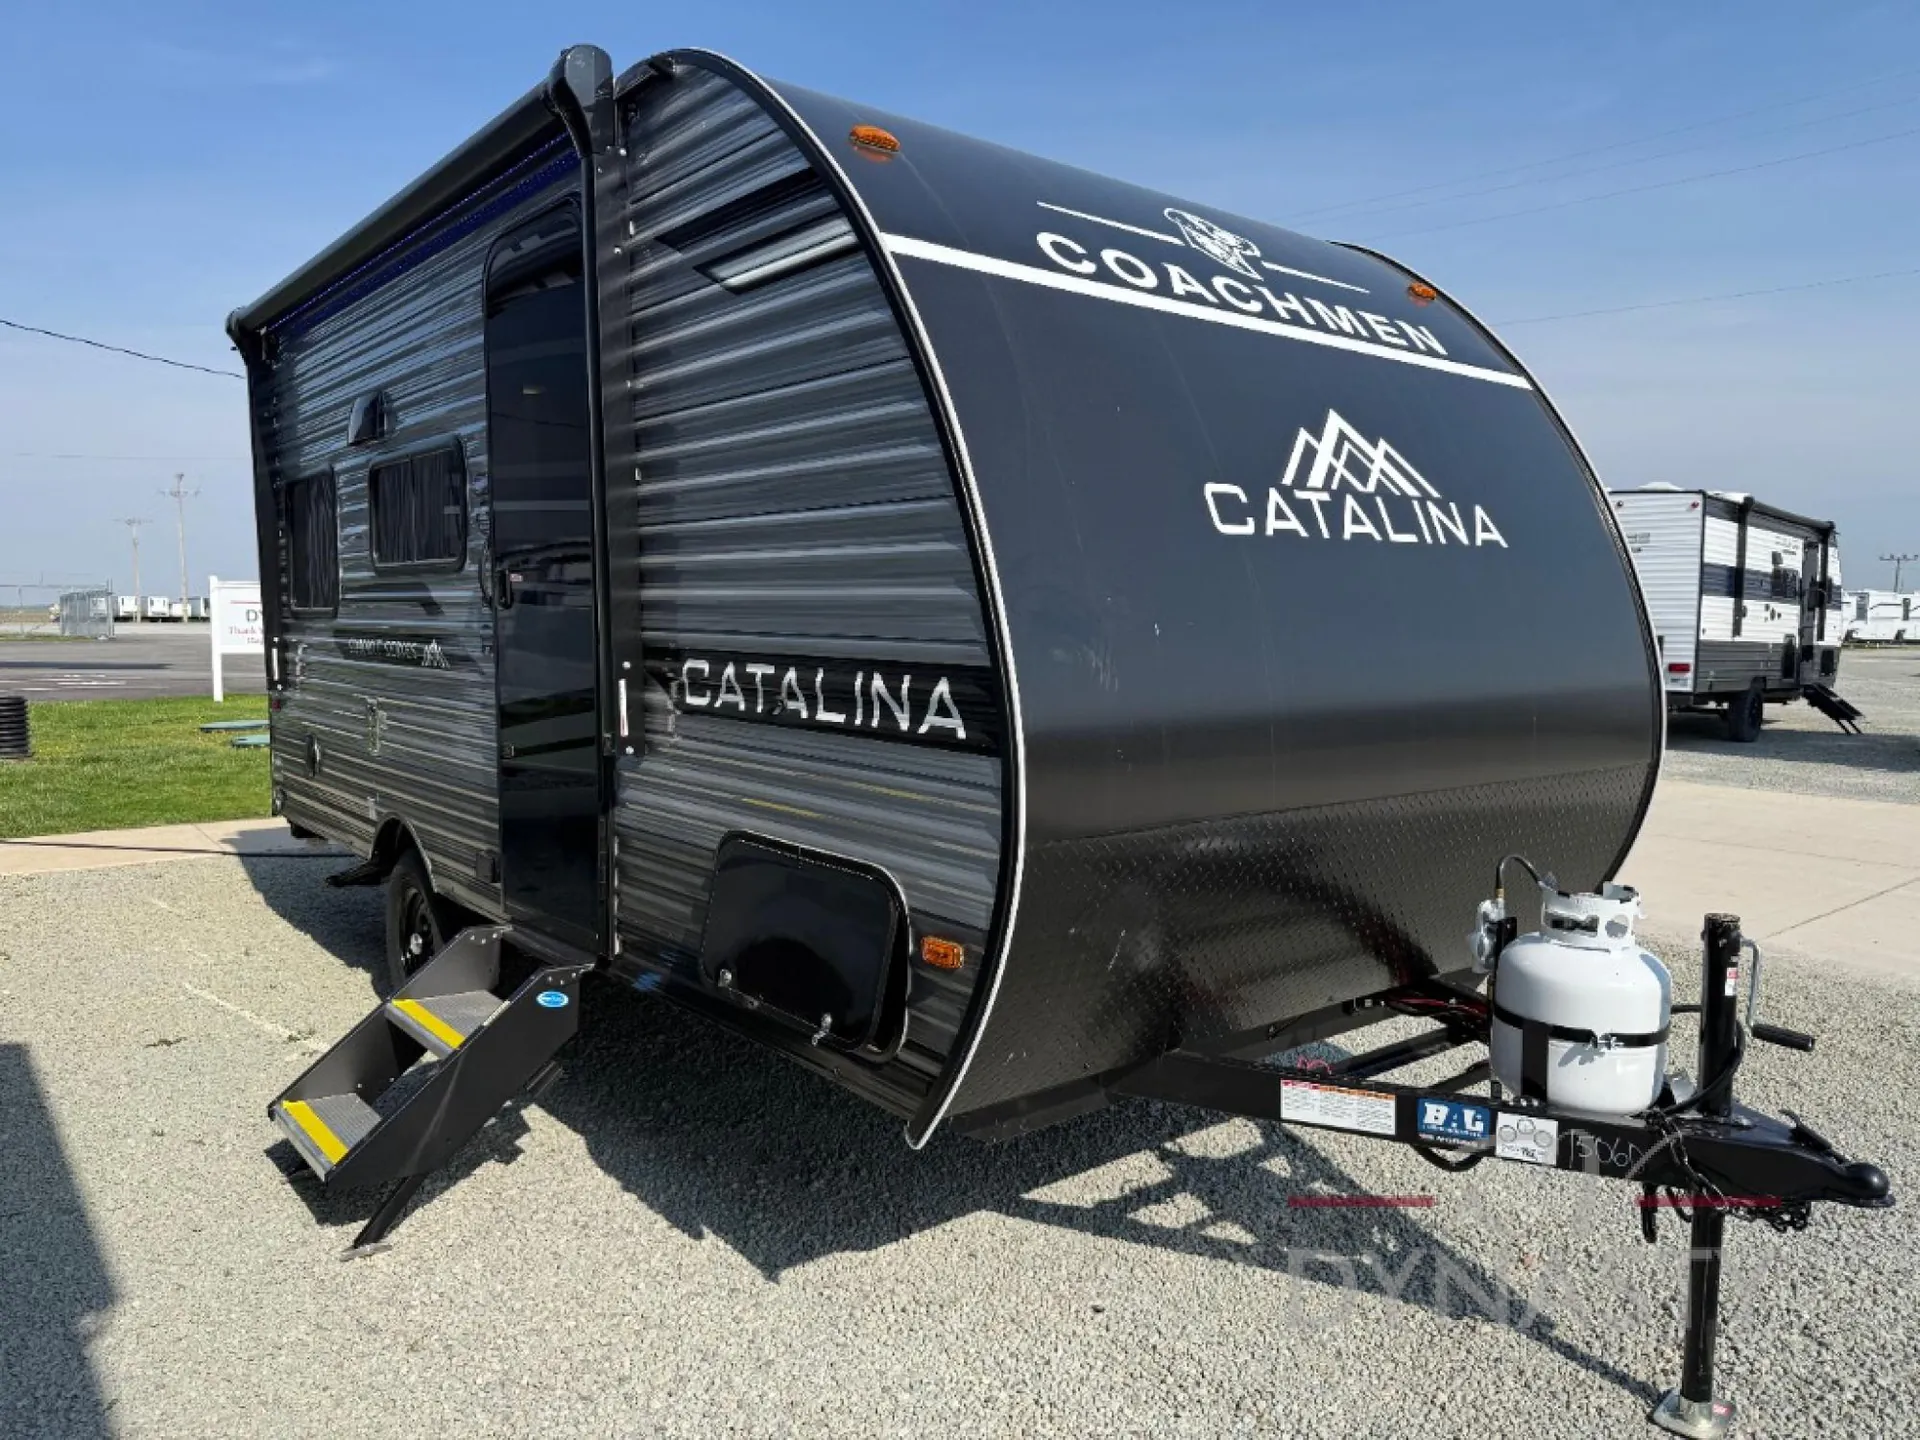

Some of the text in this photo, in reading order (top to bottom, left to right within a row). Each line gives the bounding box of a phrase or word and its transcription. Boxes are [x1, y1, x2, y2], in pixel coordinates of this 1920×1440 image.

[1036, 231, 1448, 356] COACHMEN
[1203, 481, 1509, 548] CATALINA
[682, 658, 967, 740] CATALINA
